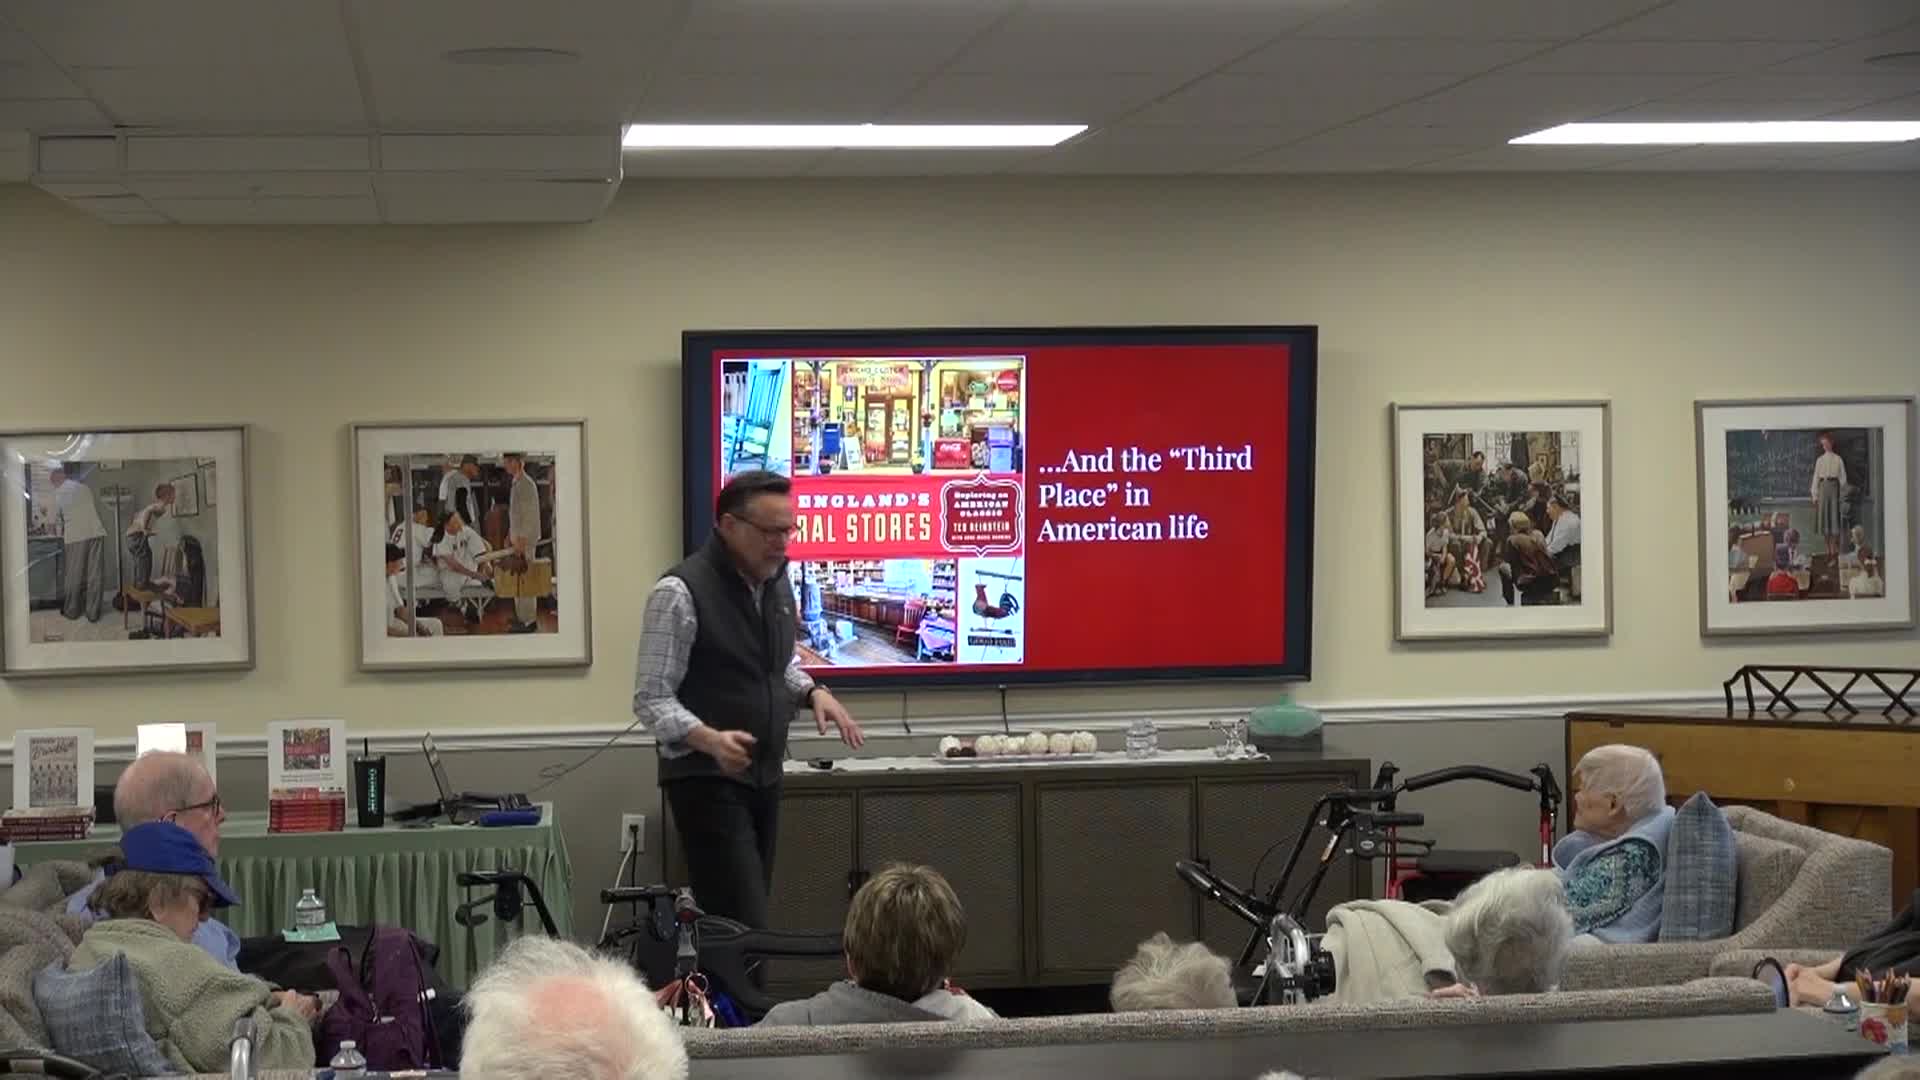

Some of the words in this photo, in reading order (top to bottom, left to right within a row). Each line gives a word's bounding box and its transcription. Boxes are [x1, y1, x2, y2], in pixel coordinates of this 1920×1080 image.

[1039, 447, 1114, 473] ...And
[1121, 447, 1162, 472] the
[1169, 445, 1253, 471] “Third
[797, 493, 930, 509] ENGLAND'S
[953, 501, 1009, 509] AMERICAN
[1038, 482, 1118, 508] Place”
[1125, 482, 1150, 506] in
[846, 512, 931, 543] STORES
[1037, 517, 1162, 542] American
[1168, 515, 1209, 539] life
